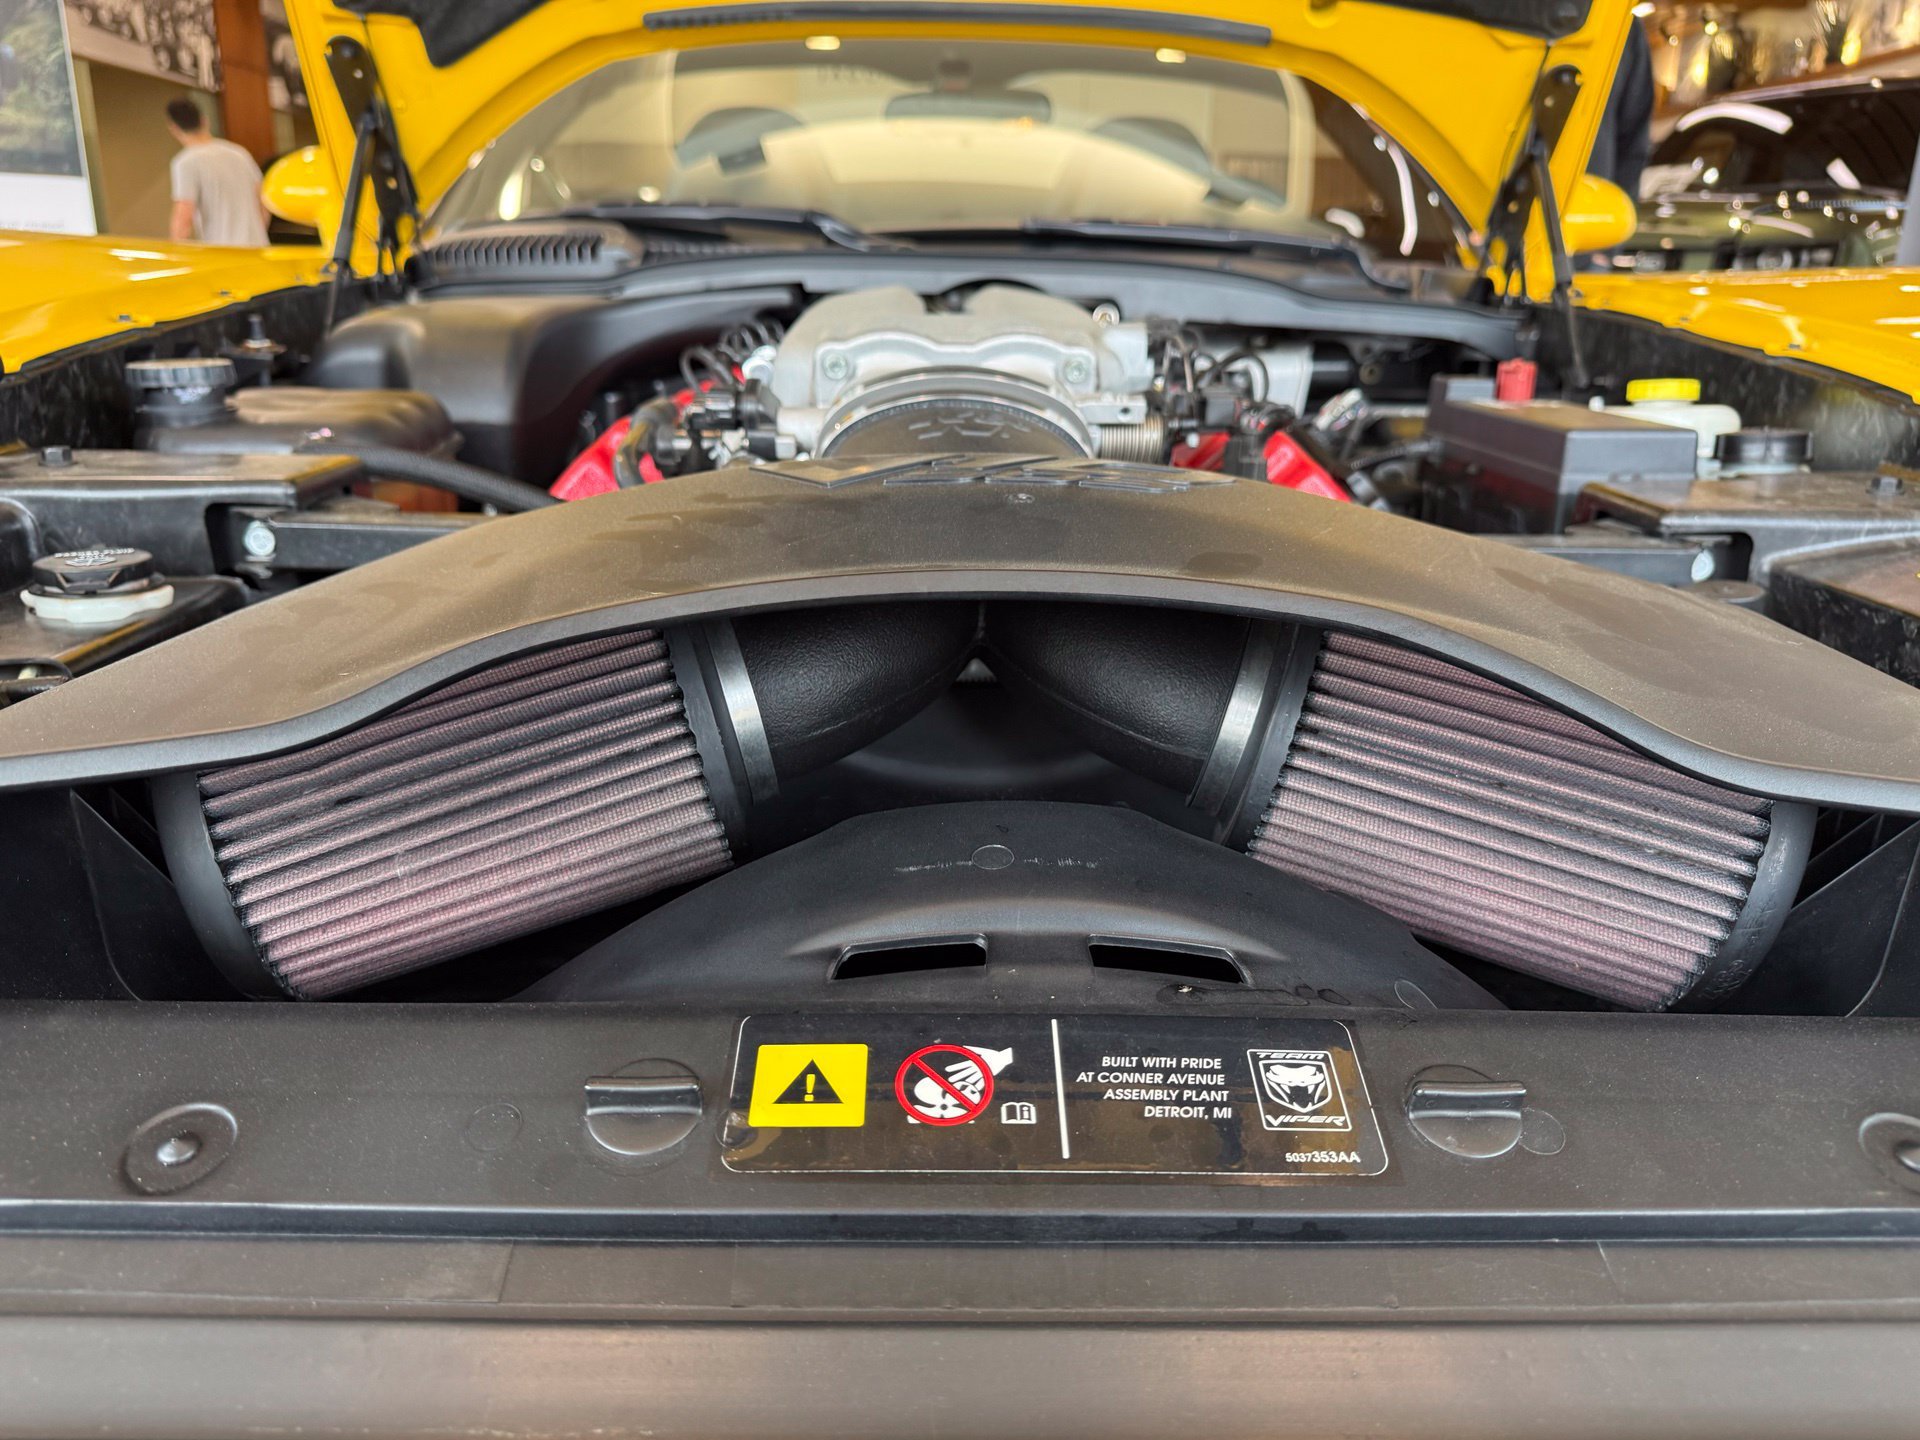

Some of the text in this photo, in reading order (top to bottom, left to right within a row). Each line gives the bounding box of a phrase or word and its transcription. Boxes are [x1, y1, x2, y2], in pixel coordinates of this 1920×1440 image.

[1101, 1056, 1222, 1069] BUILT WITH PRIDE
[1256, 1052, 1325, 1060] TEAM
[1076, 1071, 1225, 1085] AT CONNER AVENUE
[1103, 1088, 1230, 1101] ASSEMBLY PLANT
[1144, 1106, 1232, 1120] DETROIT, MI
[1265, 1114, 1347, 1127] VIPER
[1285, 1151, 1361, 1163] 5037353AA
